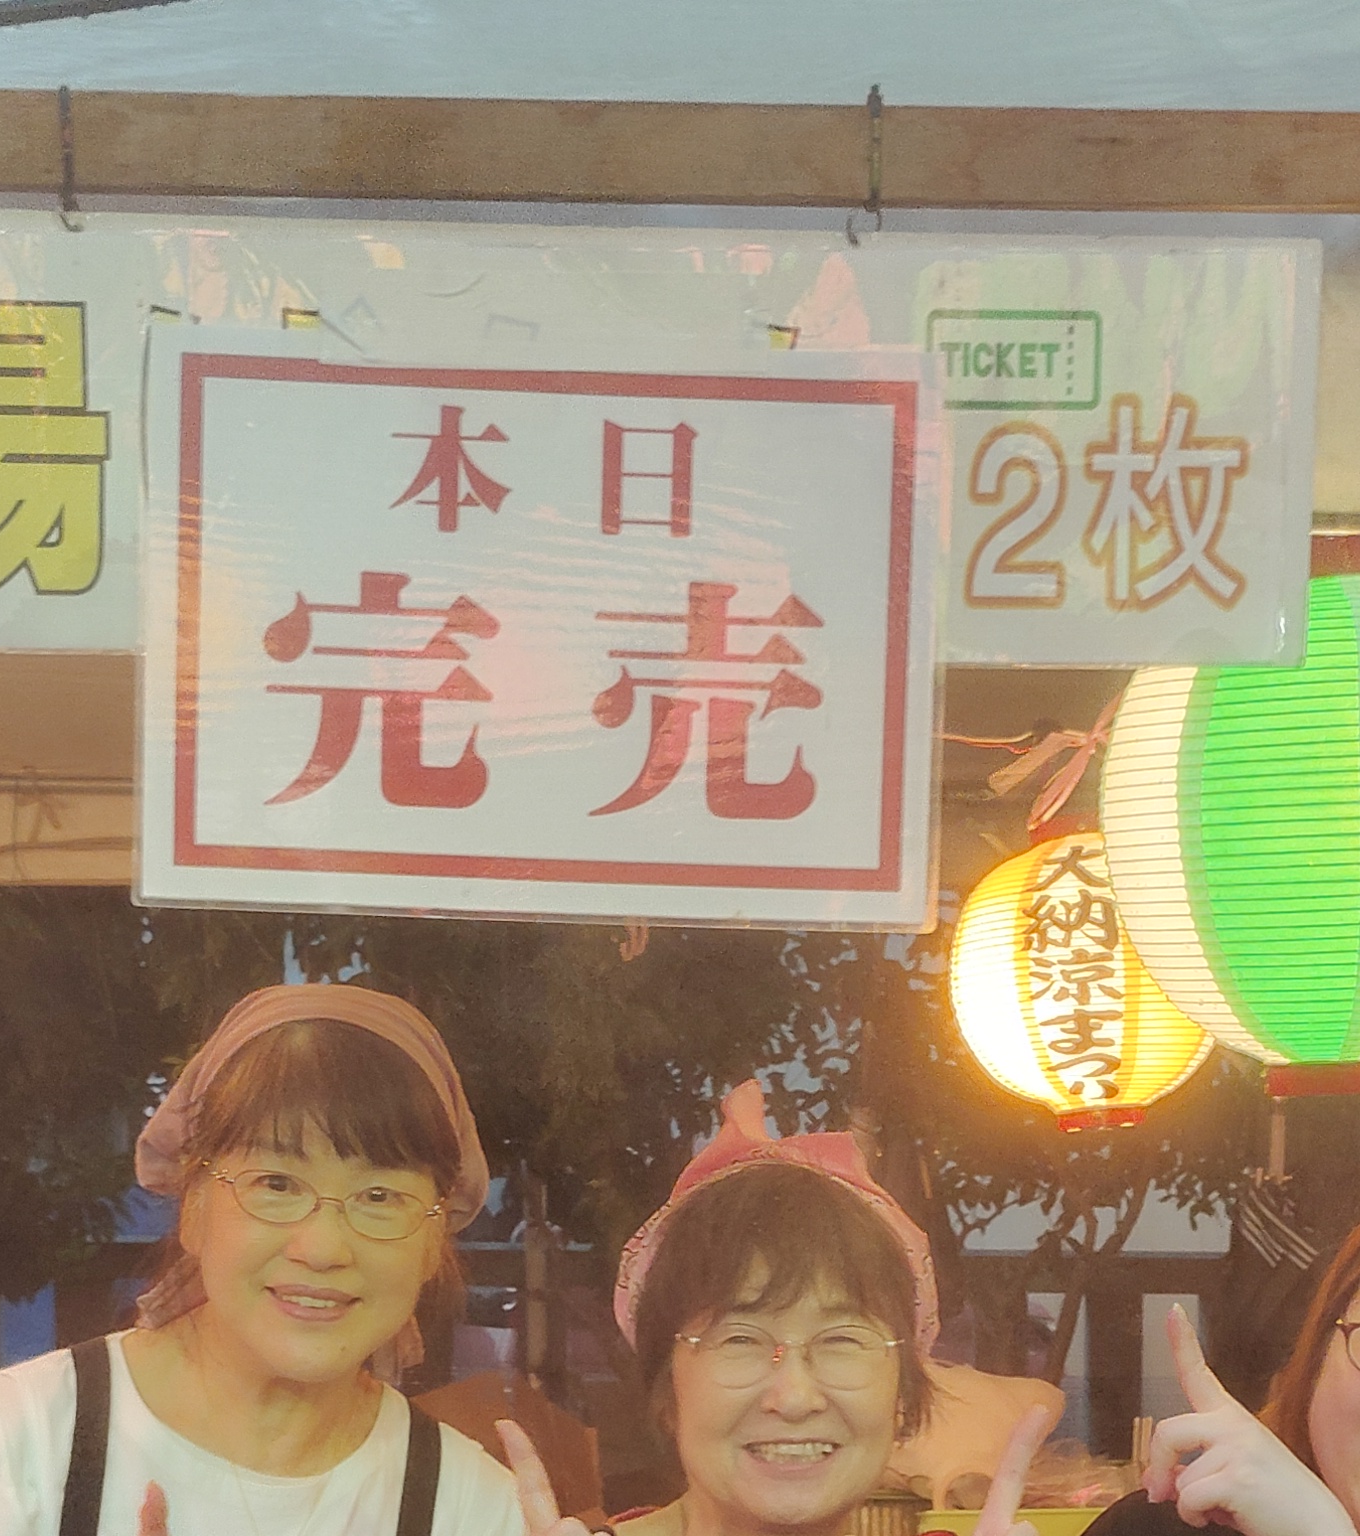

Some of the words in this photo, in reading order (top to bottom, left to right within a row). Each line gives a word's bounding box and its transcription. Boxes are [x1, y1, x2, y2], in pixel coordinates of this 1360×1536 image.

[391, 404, 700, 538] 本日
[939, 341, 1062, 379] TICKET
[963, 391, 1250, 613] 2枚
[263, 570, 826, 821] 完売
[1022, 843, 1118, 1099] 大納涼まつり
